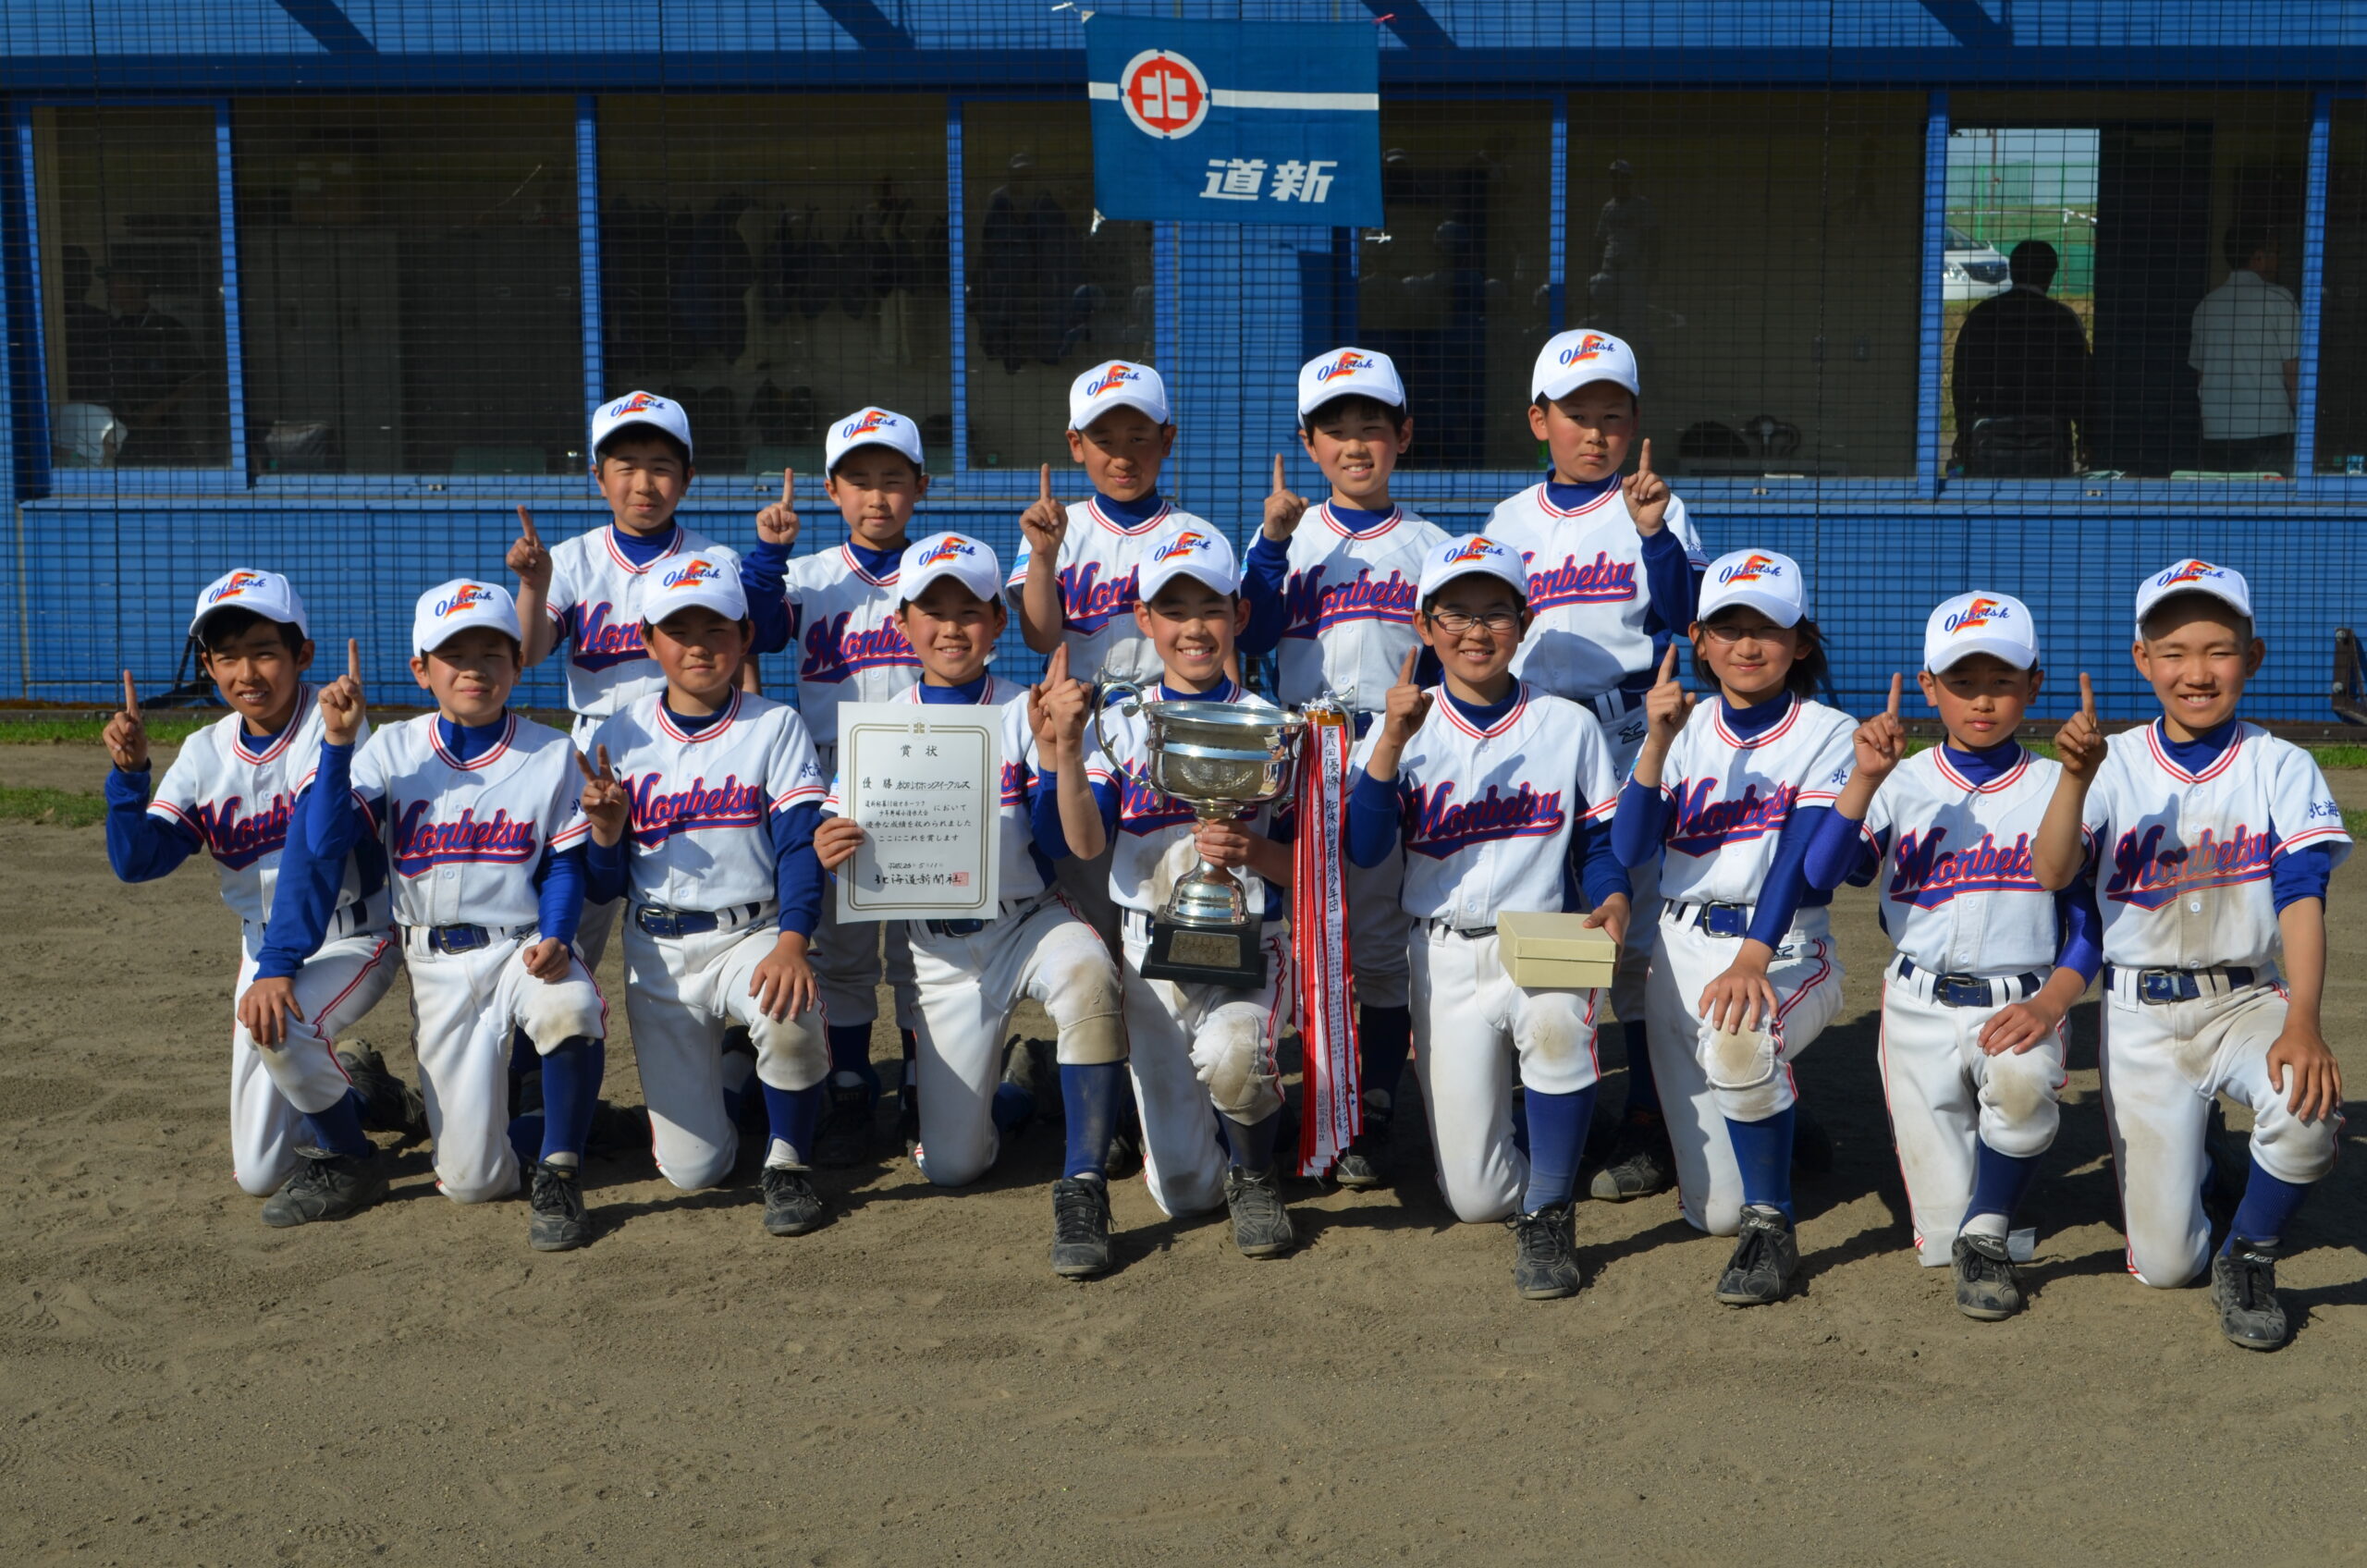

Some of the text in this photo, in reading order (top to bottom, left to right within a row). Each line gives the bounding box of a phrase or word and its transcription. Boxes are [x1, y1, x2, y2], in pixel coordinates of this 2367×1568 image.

[1141, 70, 1188, 119] 北
[1199, 158, 1338, 202] 道新
[1523, 551, 1637, 605] onbetsu
[900, 744, 938, 757] 賞状
[878, 834, 959, 842] ここにこれを賞します
[874, 873, 962, 885] 北海道新聞社
